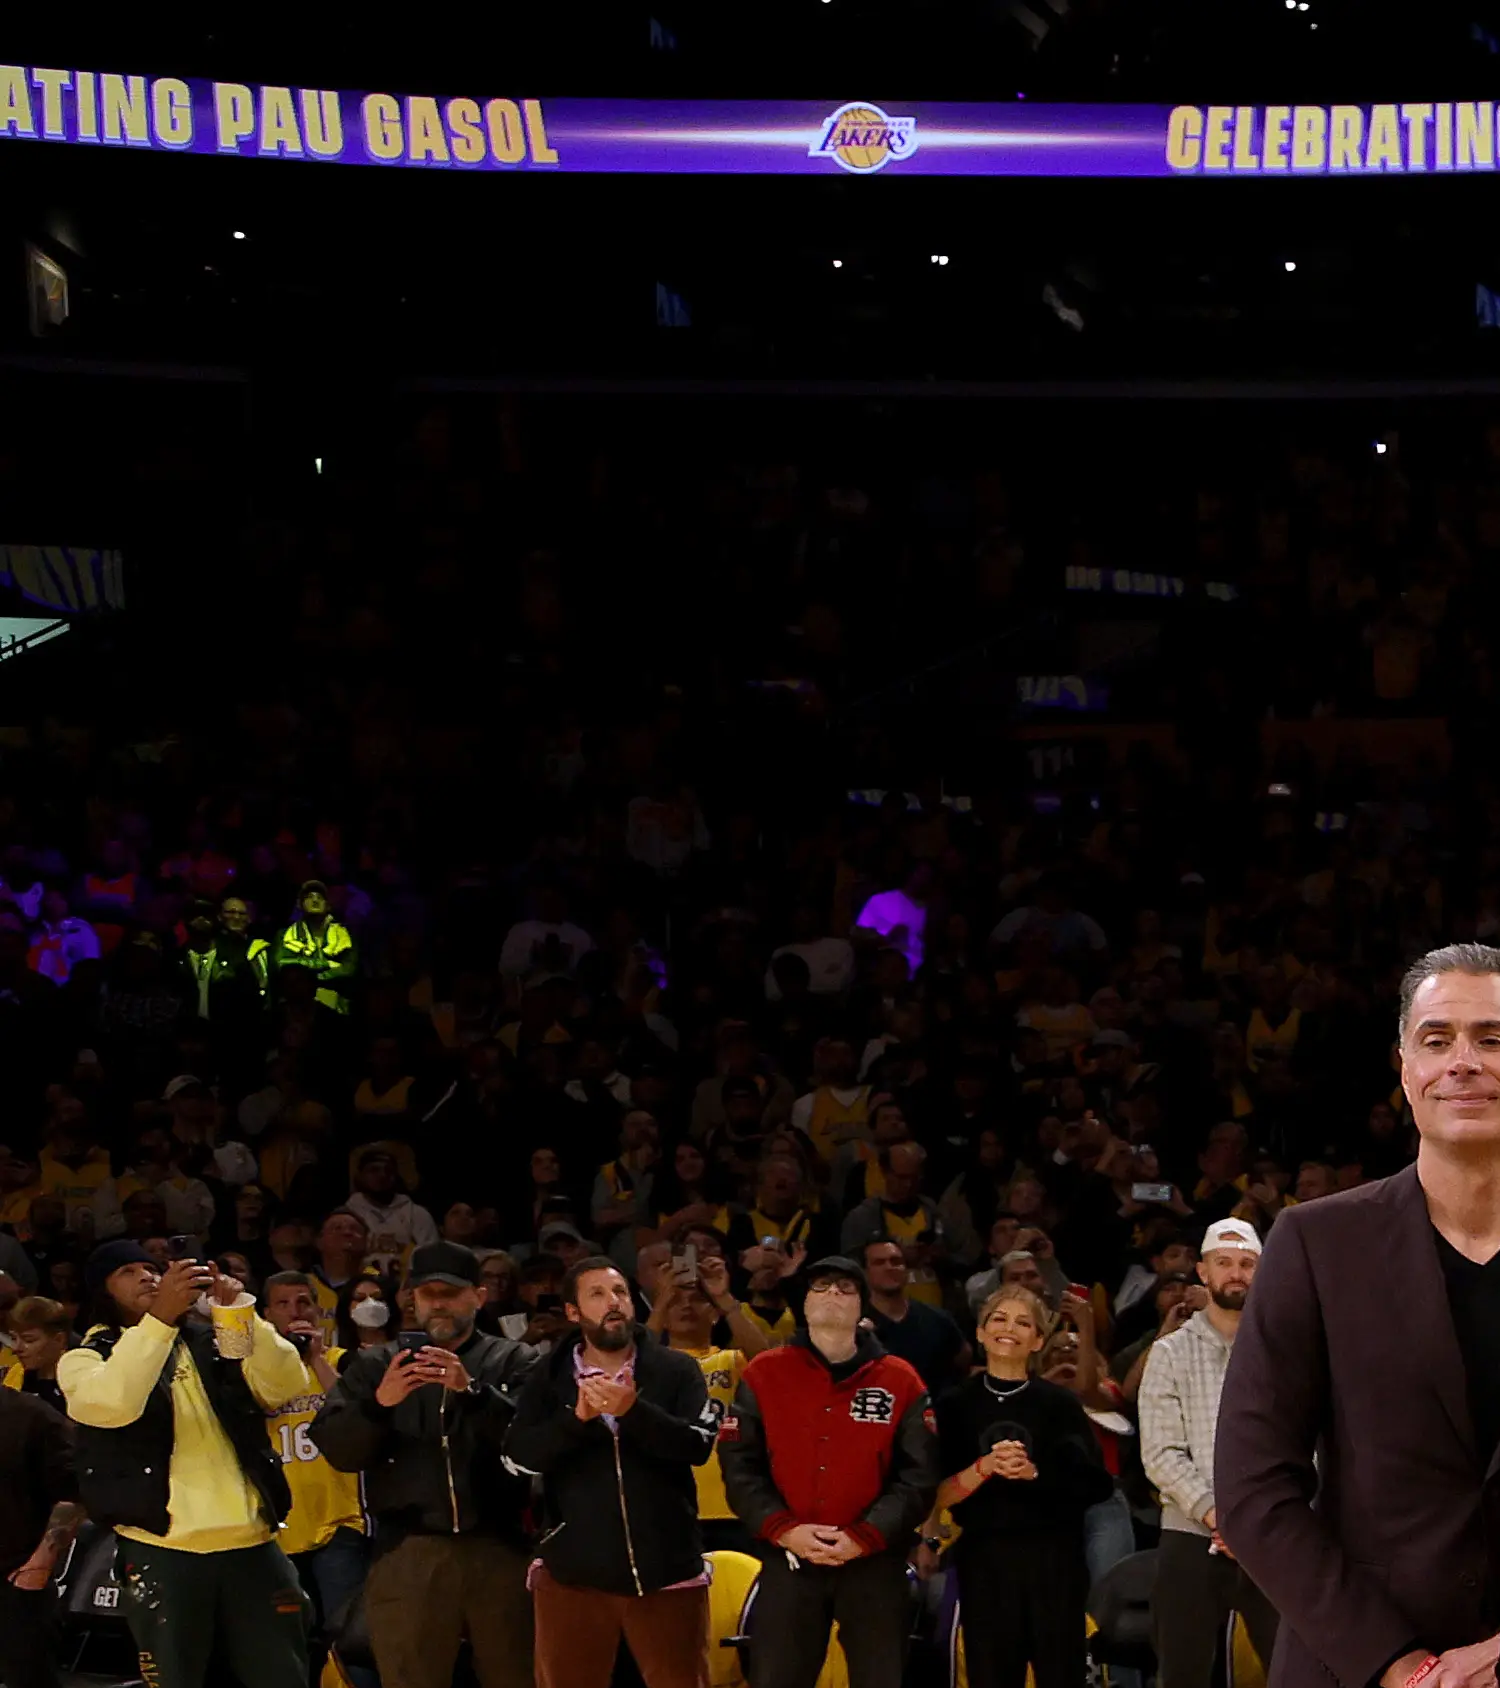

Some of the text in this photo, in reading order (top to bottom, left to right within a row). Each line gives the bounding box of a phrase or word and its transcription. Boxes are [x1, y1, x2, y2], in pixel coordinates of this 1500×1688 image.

[214, 80, 345, 155] PAU
[363, 91, 560, 165] GASOL
[818, 120, 910, 154] LAKERS
[277, 1421, 320, 1463] 16
[93, 1585, 120, 1608] GET
